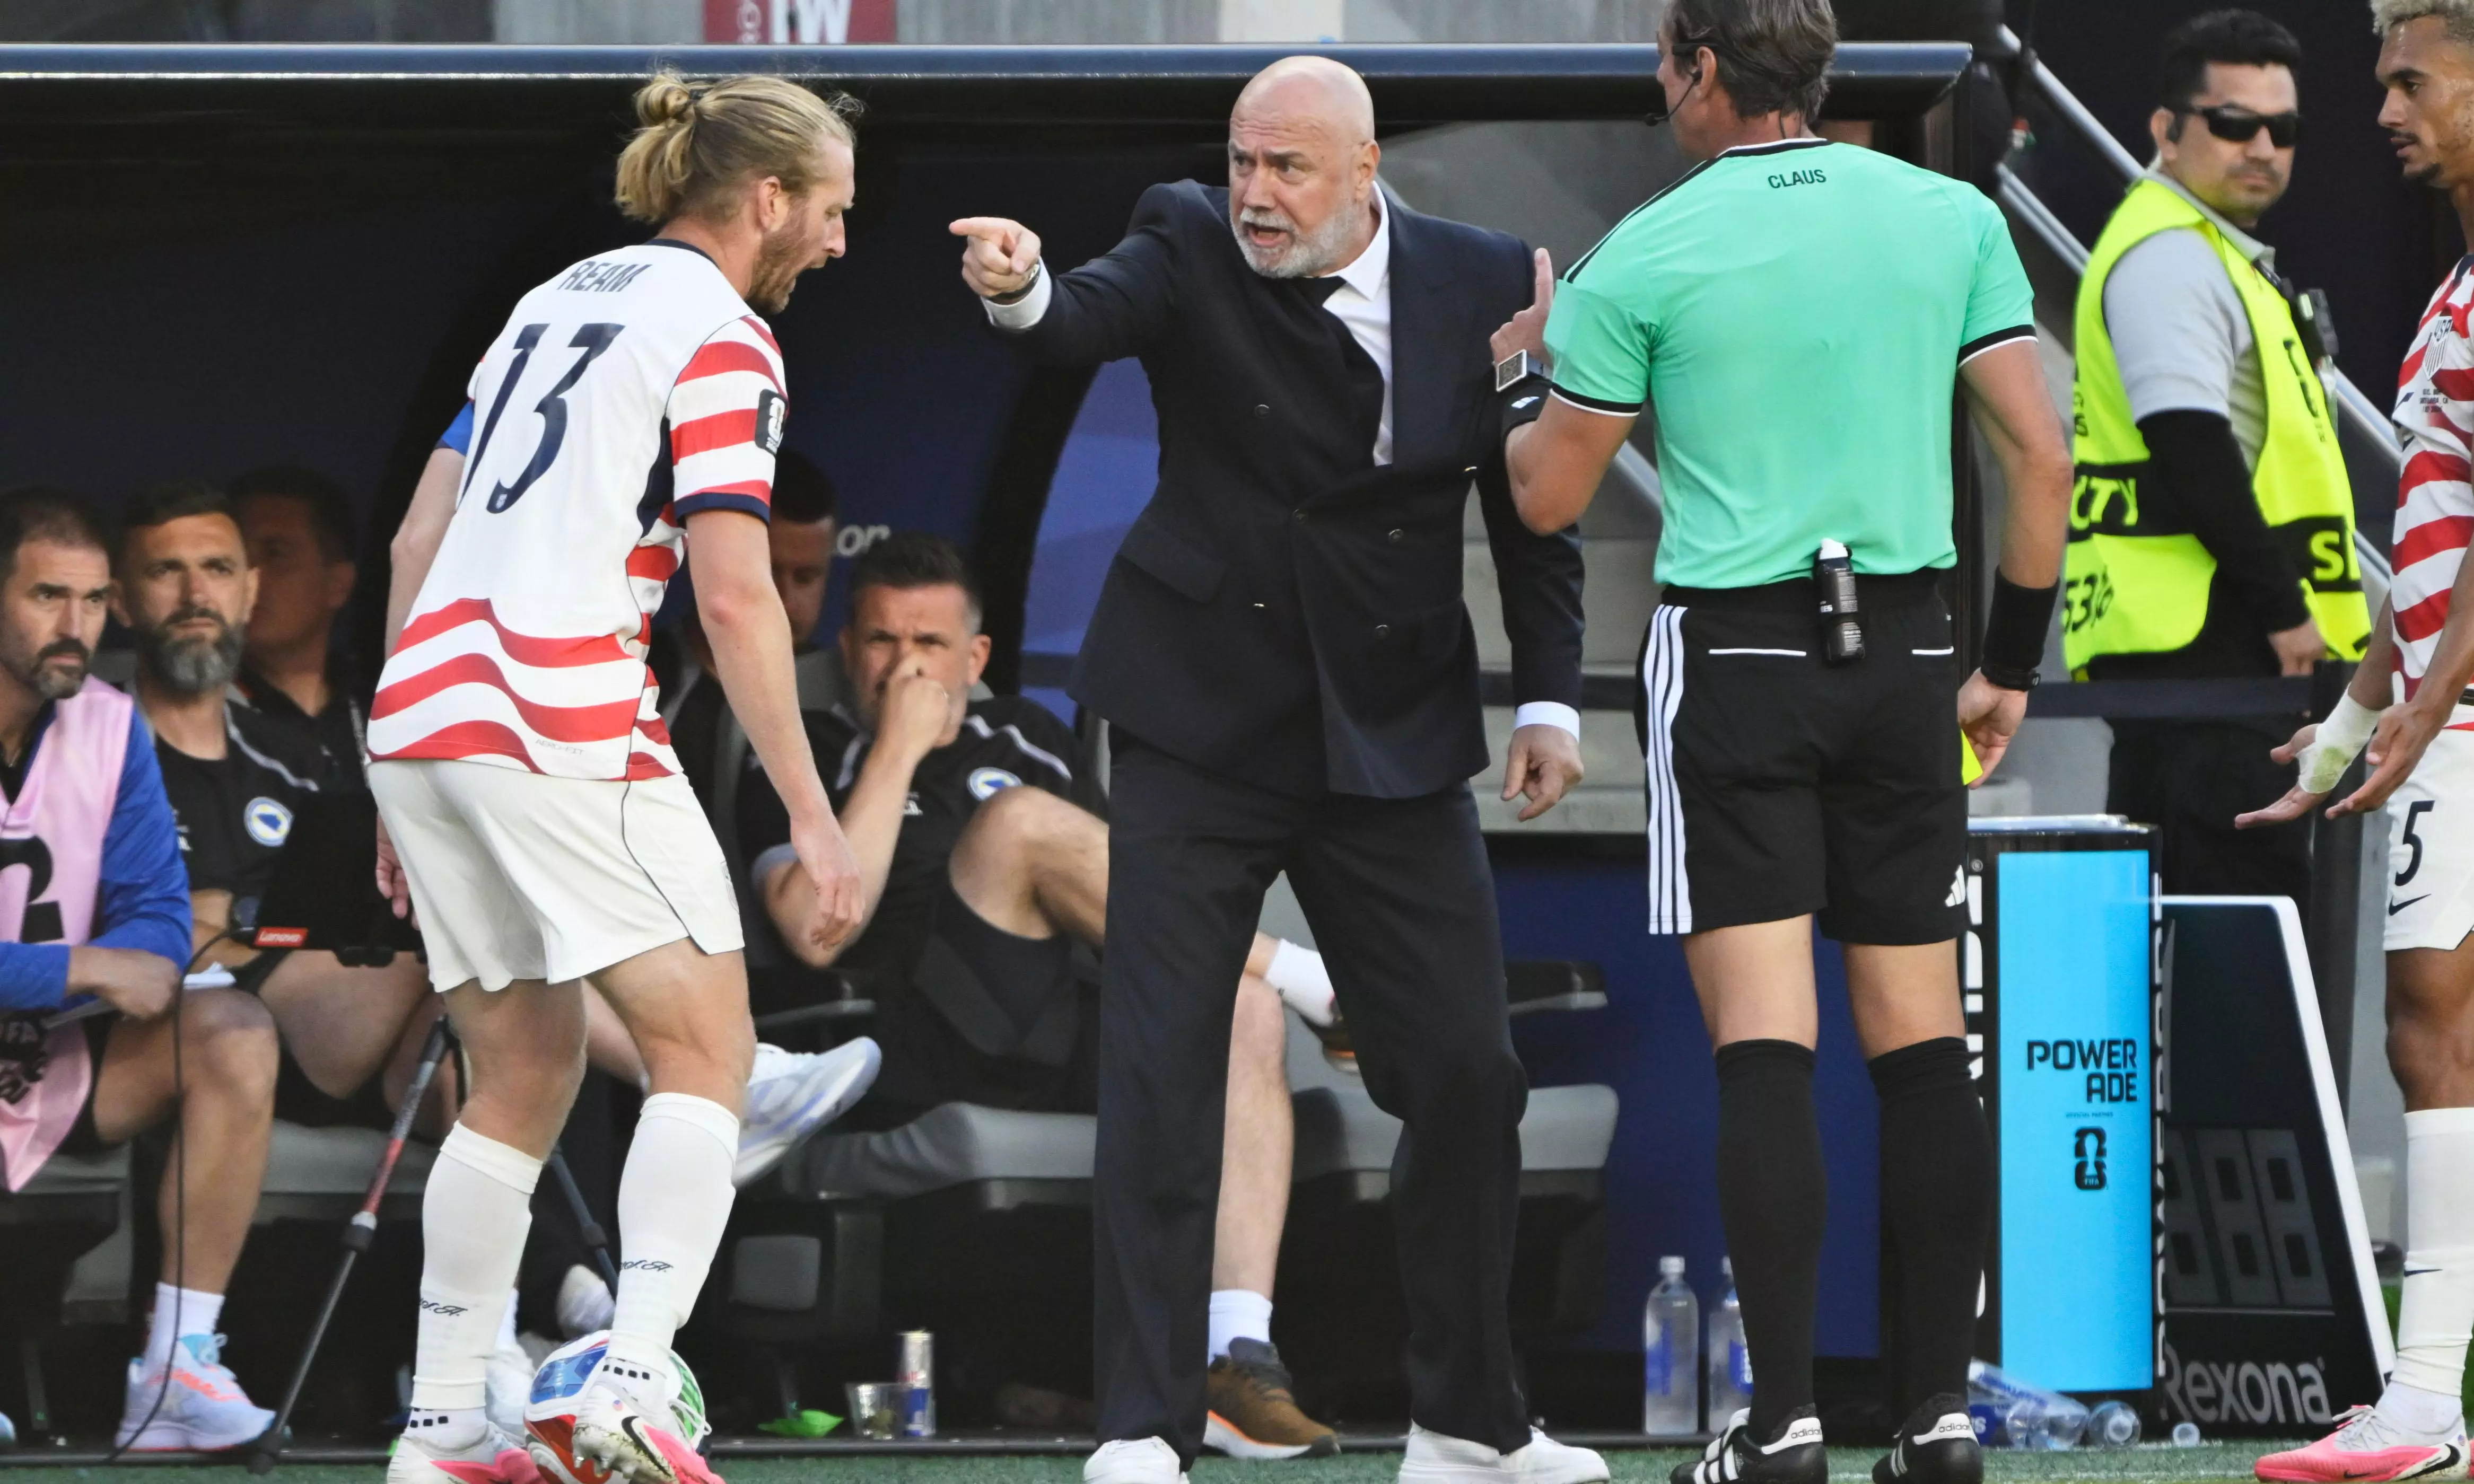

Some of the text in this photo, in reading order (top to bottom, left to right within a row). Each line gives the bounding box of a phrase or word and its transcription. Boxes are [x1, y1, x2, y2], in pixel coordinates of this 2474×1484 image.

[1767, 169, 1827, 189] CLAUS
[556, 261, 653, 292] REAM
[456, 322, 626, 514] 13
[2394, 800, 2435, 887] 5
[2027, 1039, 2137, 1070] POWER
[2086, 1073, 2138, 1103] ADE
[2160, 1342, 2333, 1425] Rexona
[1791, 1428, 1822, 1439] adida
[1938, 1422, 1970, 1433] adida
